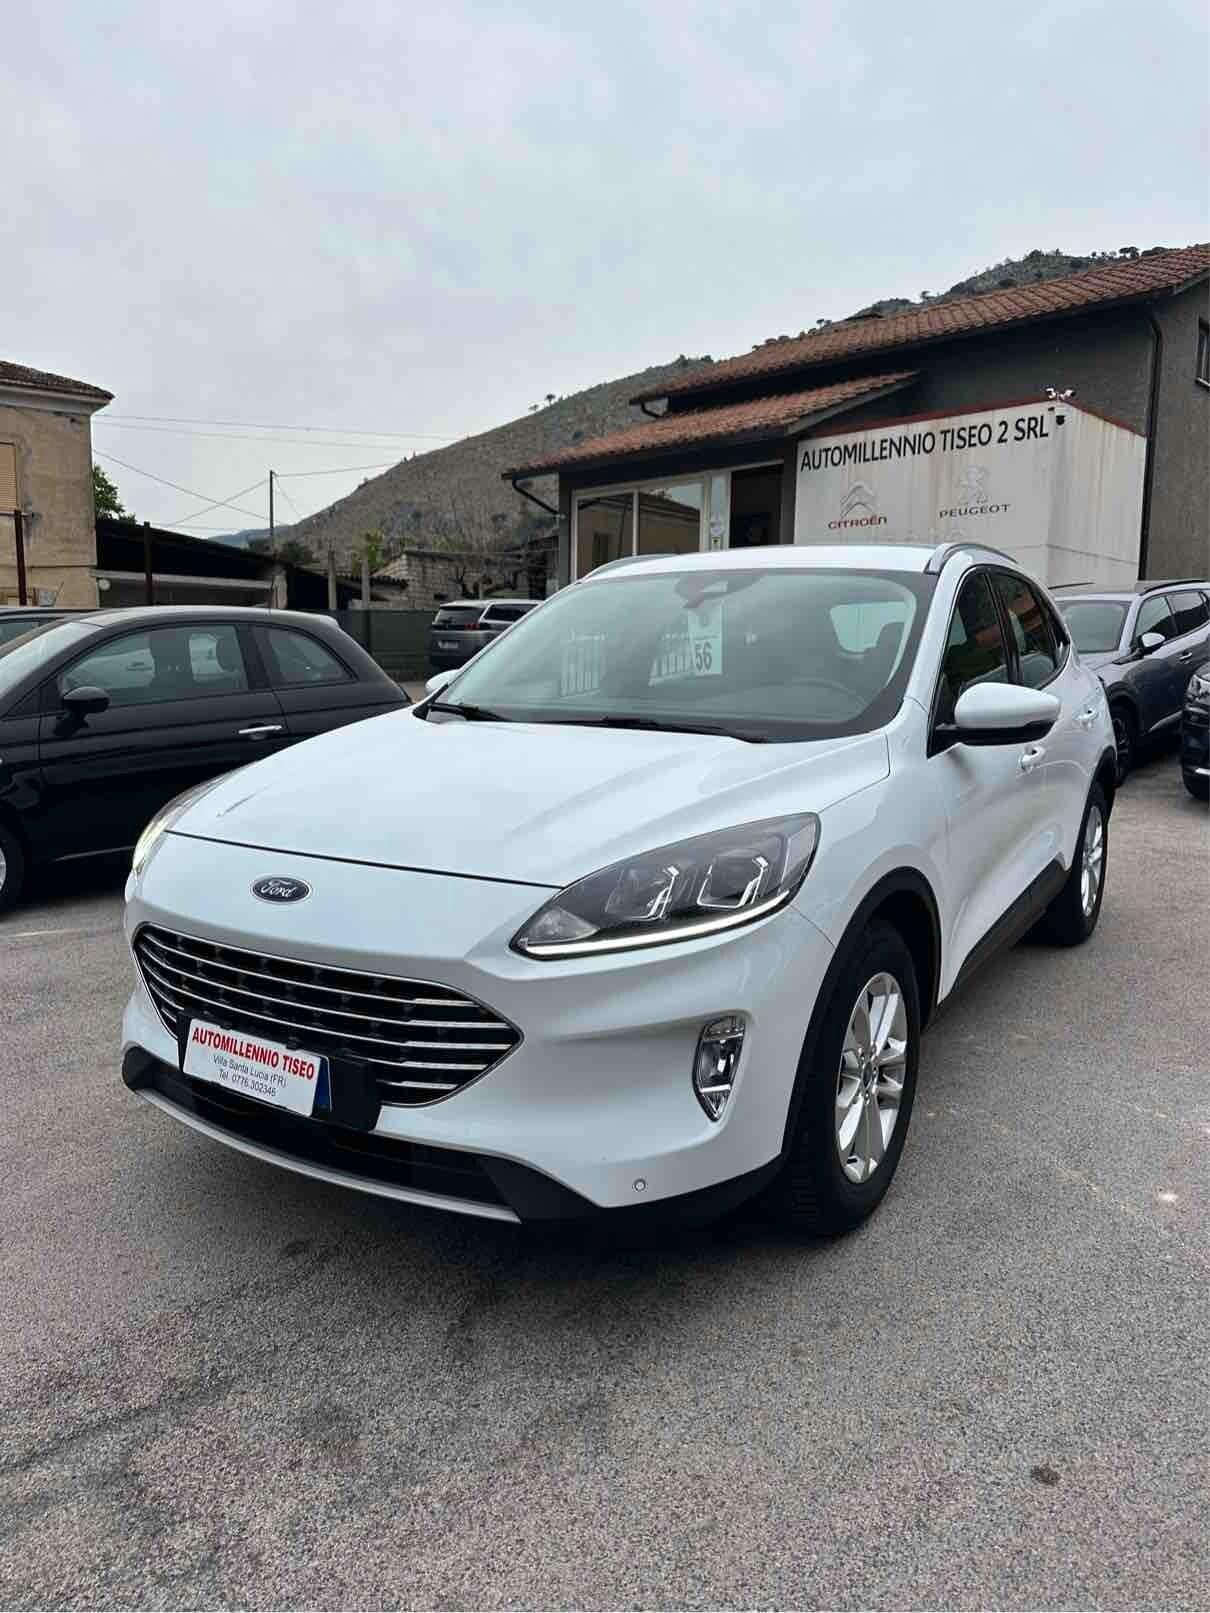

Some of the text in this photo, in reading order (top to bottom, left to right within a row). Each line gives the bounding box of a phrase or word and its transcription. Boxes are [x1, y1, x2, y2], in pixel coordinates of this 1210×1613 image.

[800, 414, 1049, 471] AUTOMILLENNIO TISEO 2 SRL
[939, 504, 1011, 519] PEUGEOT
[260, 879, 298, 897] Ford
[192, 1027, 315, 1080] AUTOMILLENNIO TISEO
[213, 1055, 228, 1068] Villa
[229, 1059, 249, 1074] Santa
